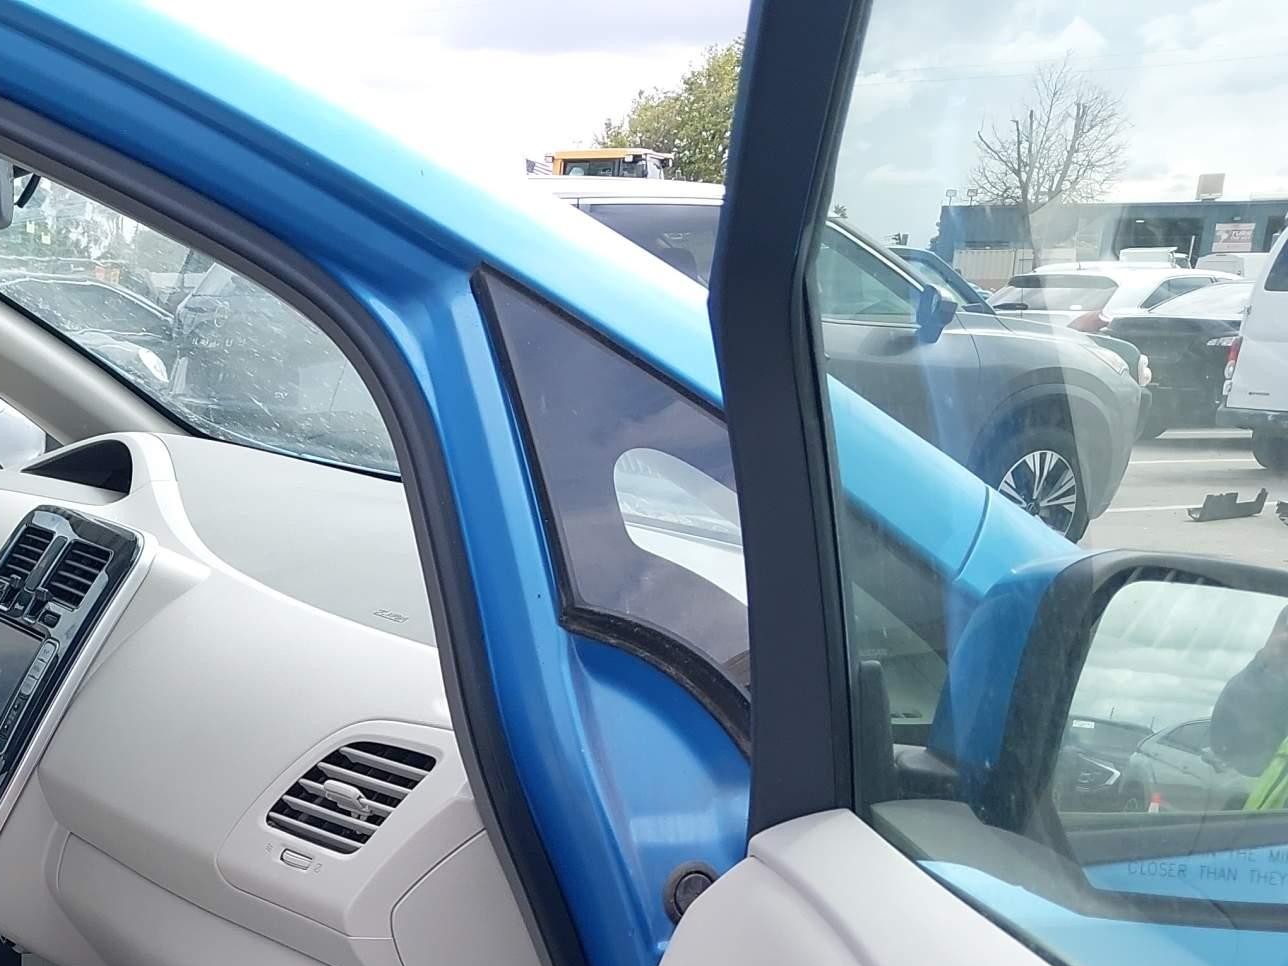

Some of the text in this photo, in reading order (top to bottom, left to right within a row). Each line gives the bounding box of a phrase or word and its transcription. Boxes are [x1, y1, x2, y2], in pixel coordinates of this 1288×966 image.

[1127, 862, 1288, 887] CLOSER THAN THEY
